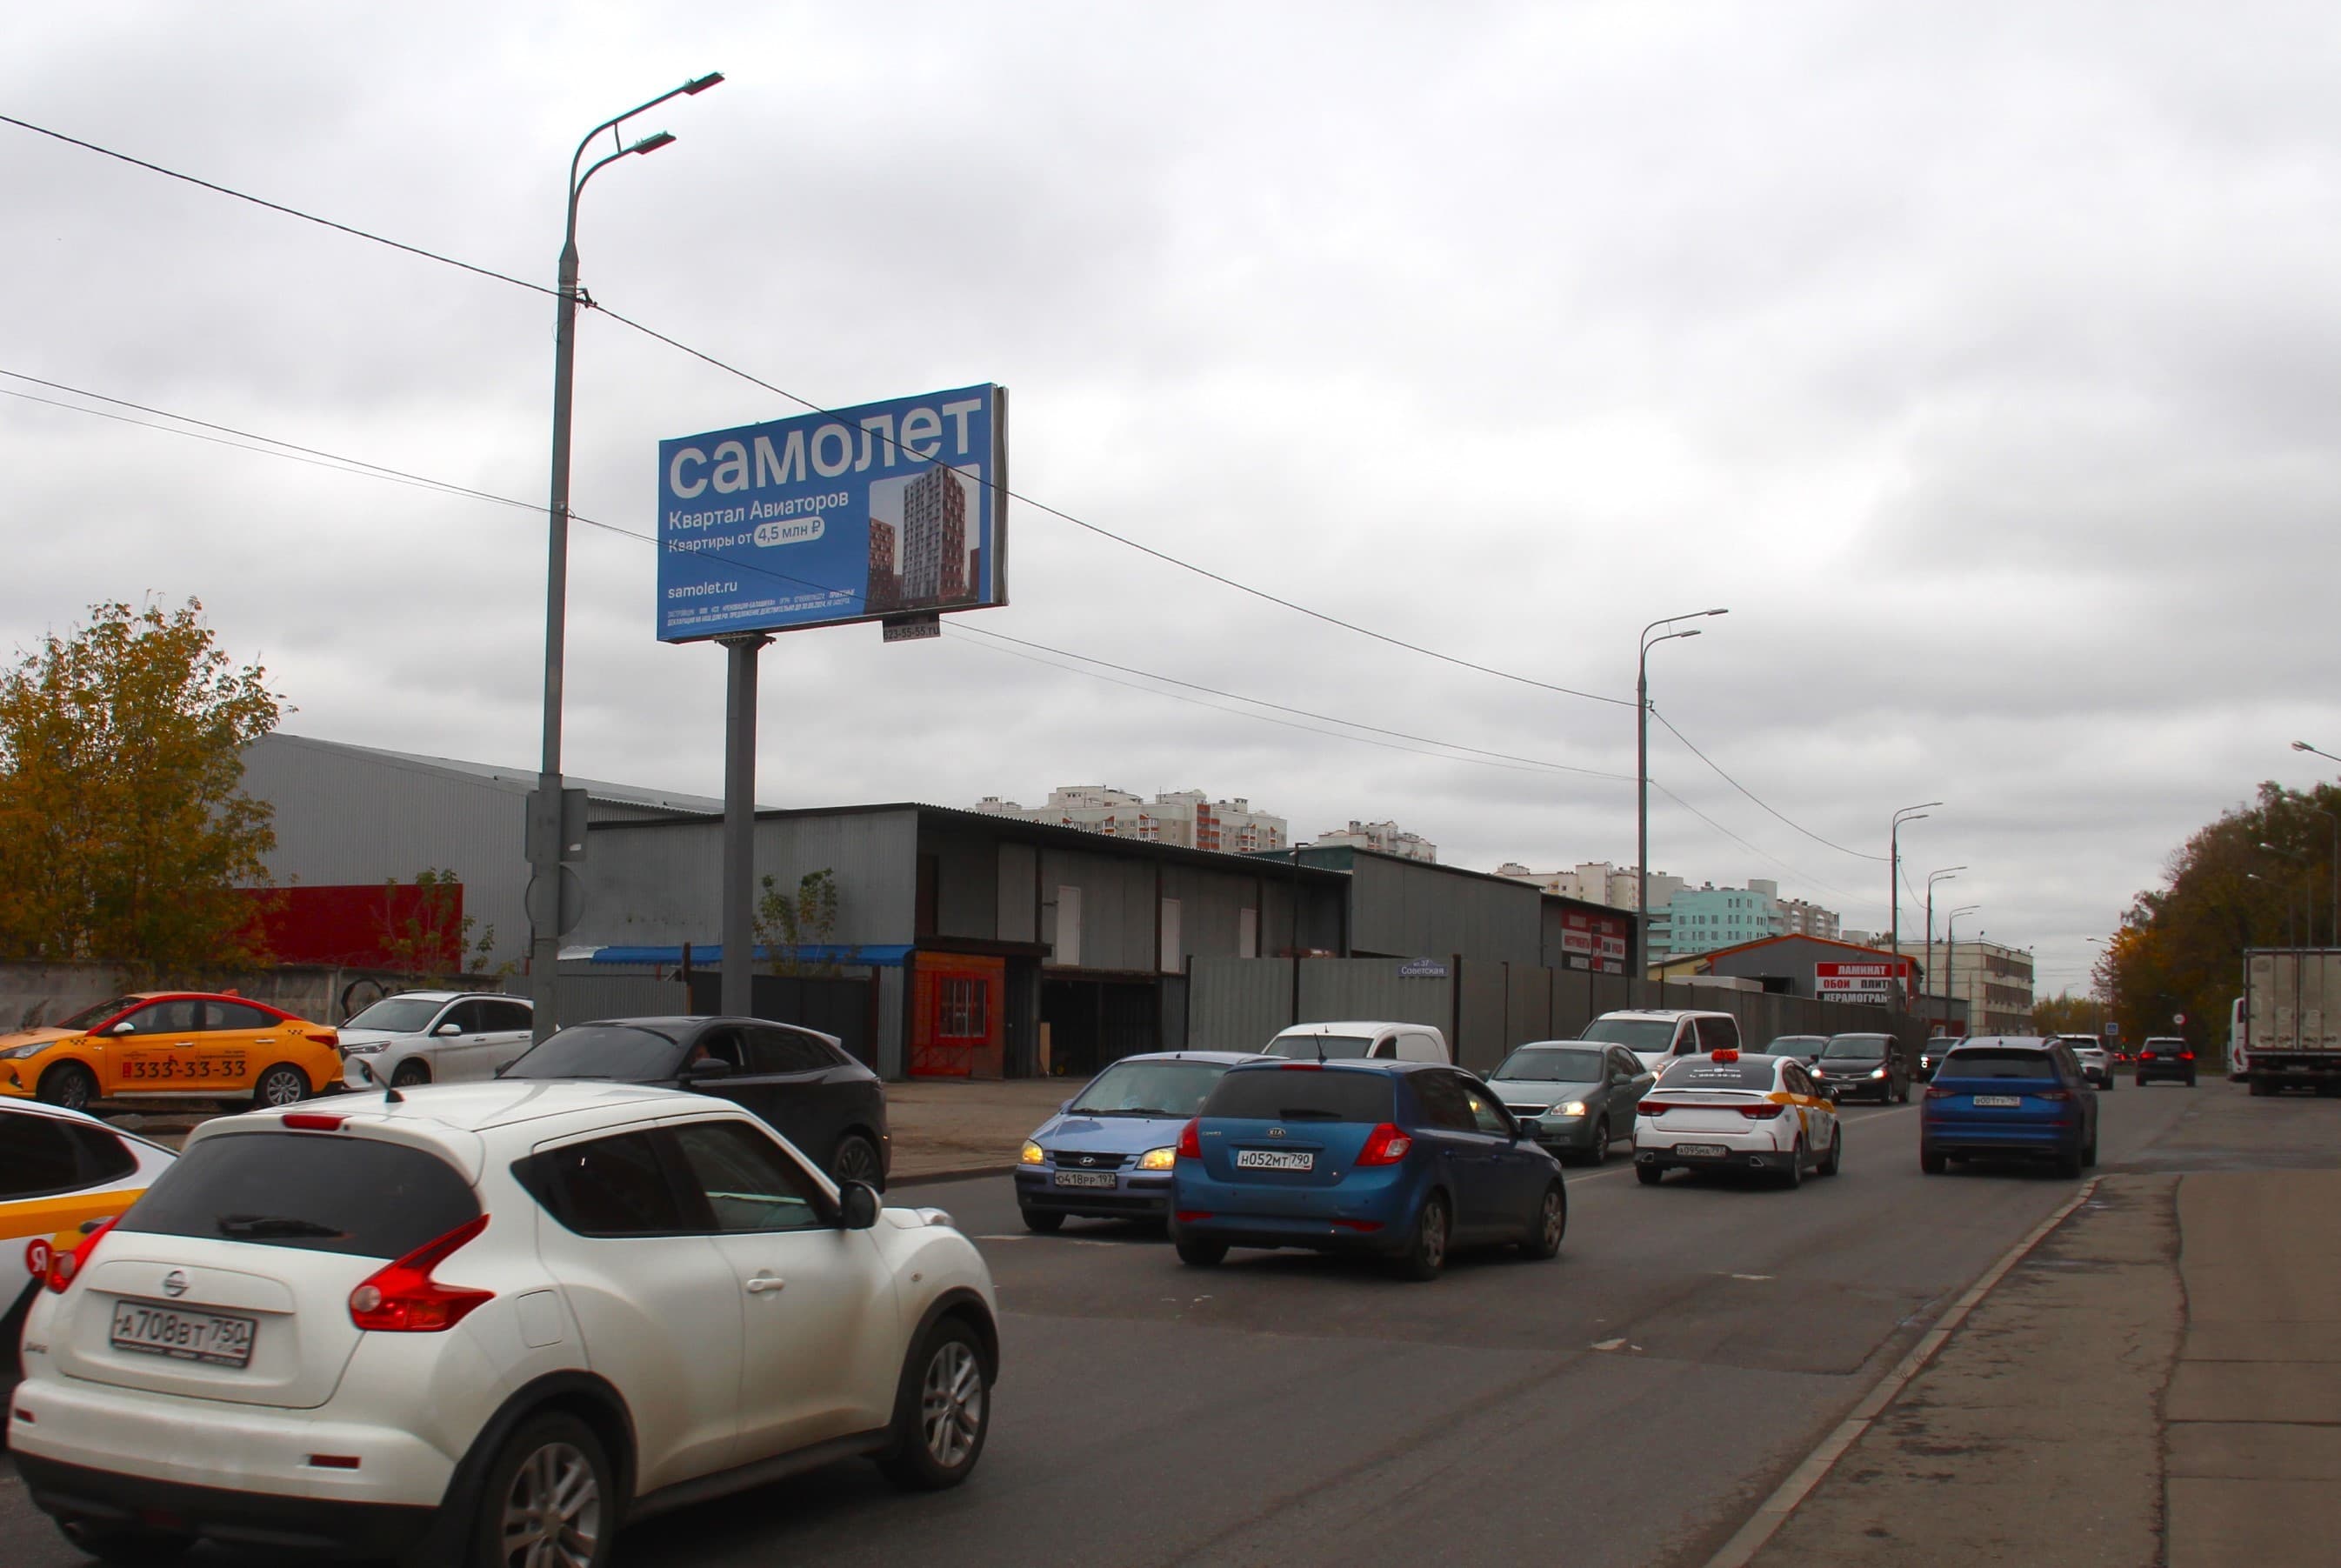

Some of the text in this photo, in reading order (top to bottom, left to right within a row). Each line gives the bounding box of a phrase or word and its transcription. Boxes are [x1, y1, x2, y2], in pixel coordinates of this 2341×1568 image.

[670, 398, 982, 499] самолет
[669, 491, 850, 530] Квартал Авиаторов
[668, 533, 735, 552] Квартиры
[737, 532, 752, 545] от
[757, 525, 779, 544] 4,5
[783, 523, 808, 538] млн
[667, 580, 738, 599] samolet.ru
[1401, 965, 1444, 975] Советская
[1837, 964, 1886, 975] ЛАМИНАТ
[1823, 978, 1890, 989] ОБОИ ПЛИТ
[1824, 992, 1890, 1003] КЕРАМОГРАН
[133, 1060, 246, 1078] 333-33-33
[1241, 1152, 1289, 1167] Н052МТ
[118, 1309, 247, 1347] А708ВТ 750
